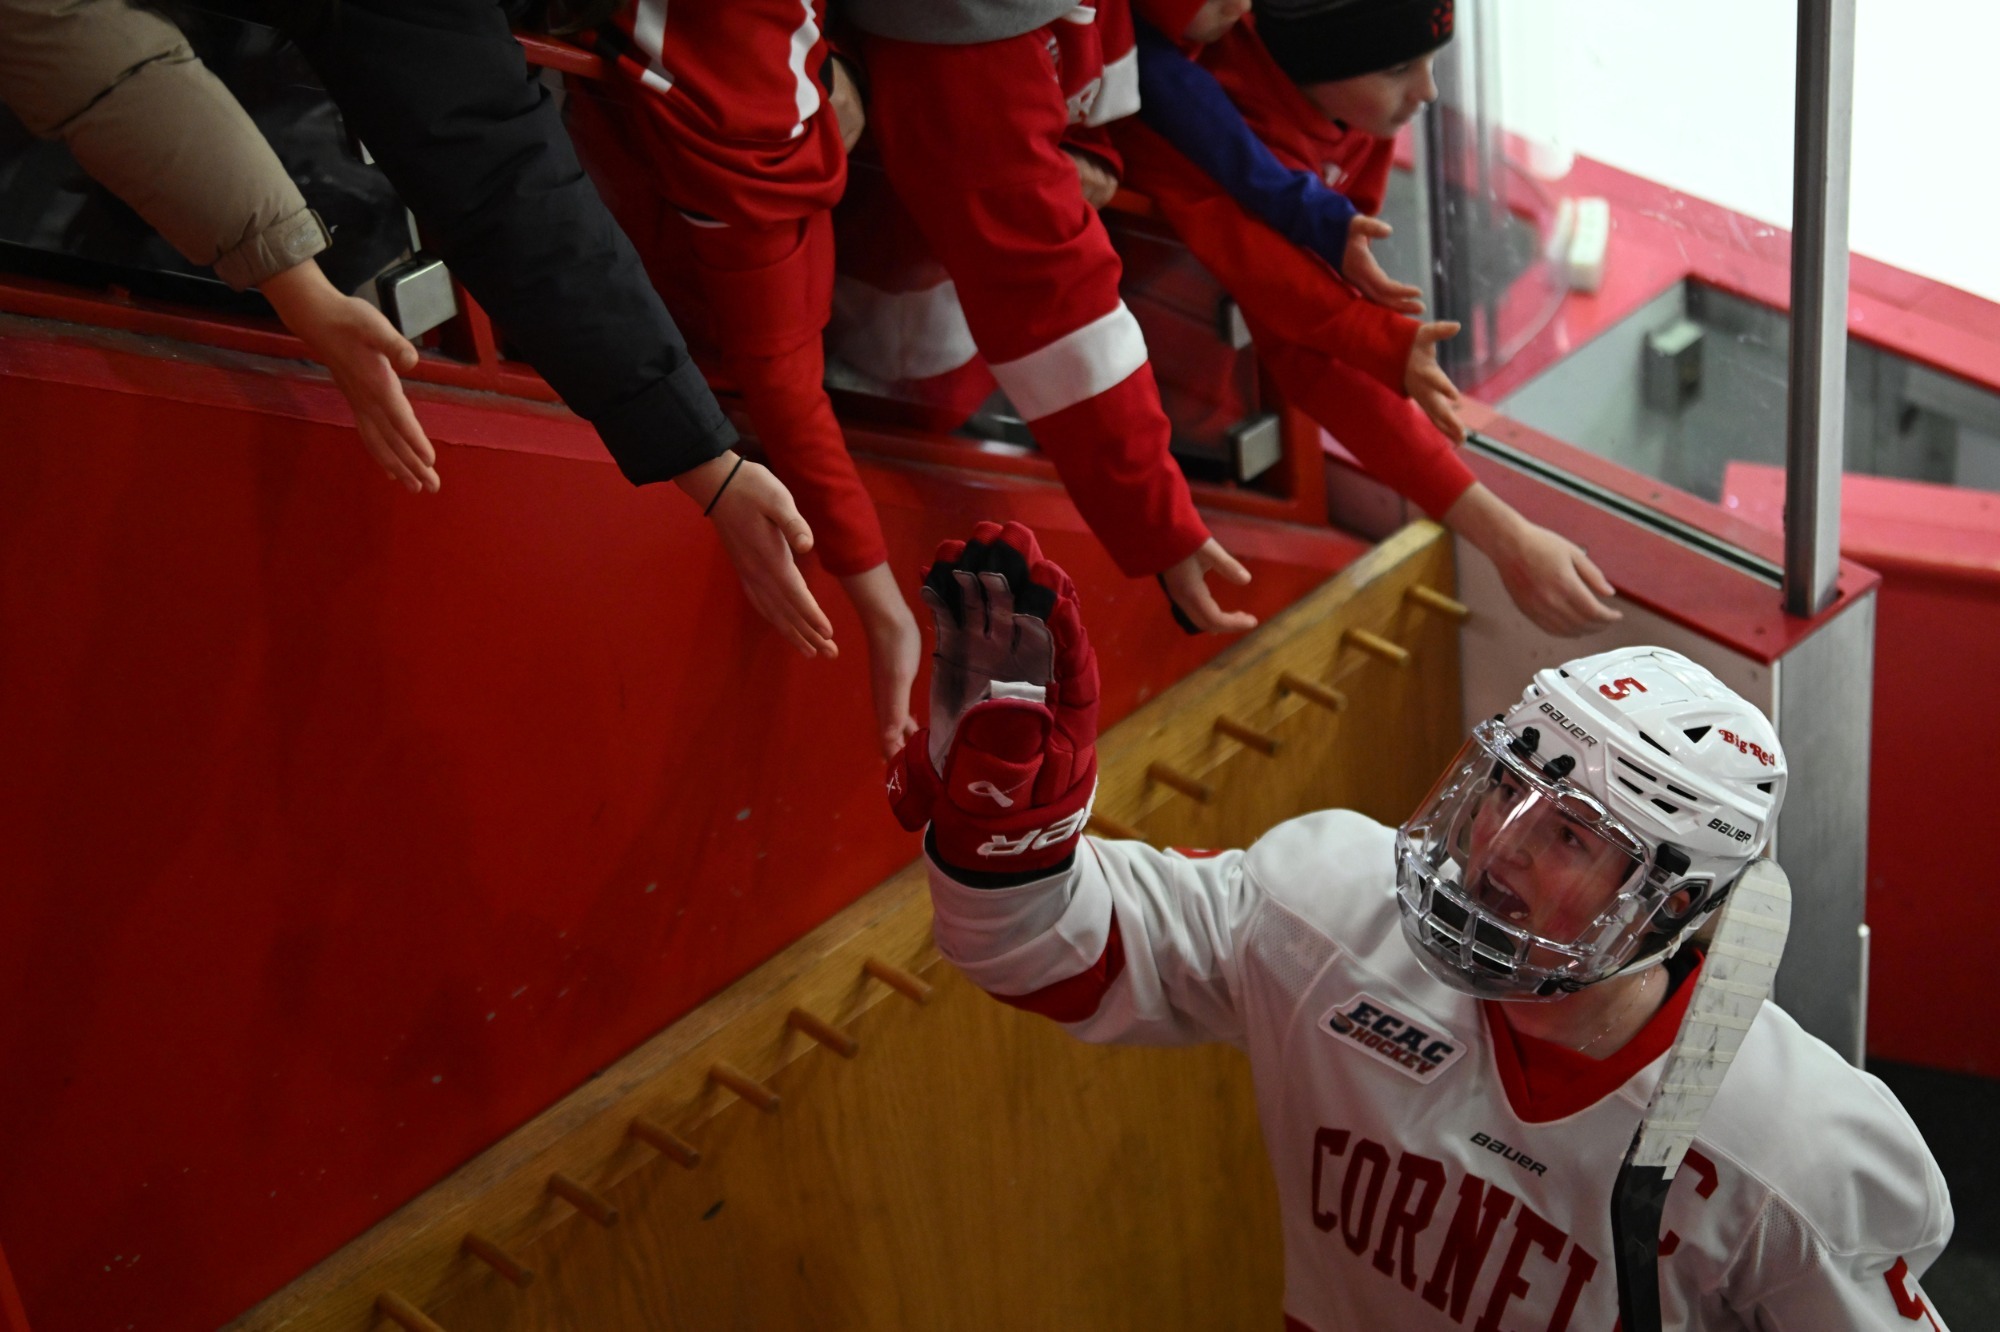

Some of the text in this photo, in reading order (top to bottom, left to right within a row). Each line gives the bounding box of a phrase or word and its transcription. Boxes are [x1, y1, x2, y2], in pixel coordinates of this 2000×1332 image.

[1599, 676, 1648, 700] 5
[1539, 702, 1597, 747] BAUER
[1718, 729, 1775, 766] Big Red
[1707, 817, 1752, 844] BAUER
[1347, 1001, 1454, 1065] ECAC
[1350, 1027, 1436, 1075] HOCKEY
[1470, 1132, 1547, 1177] BAUER
